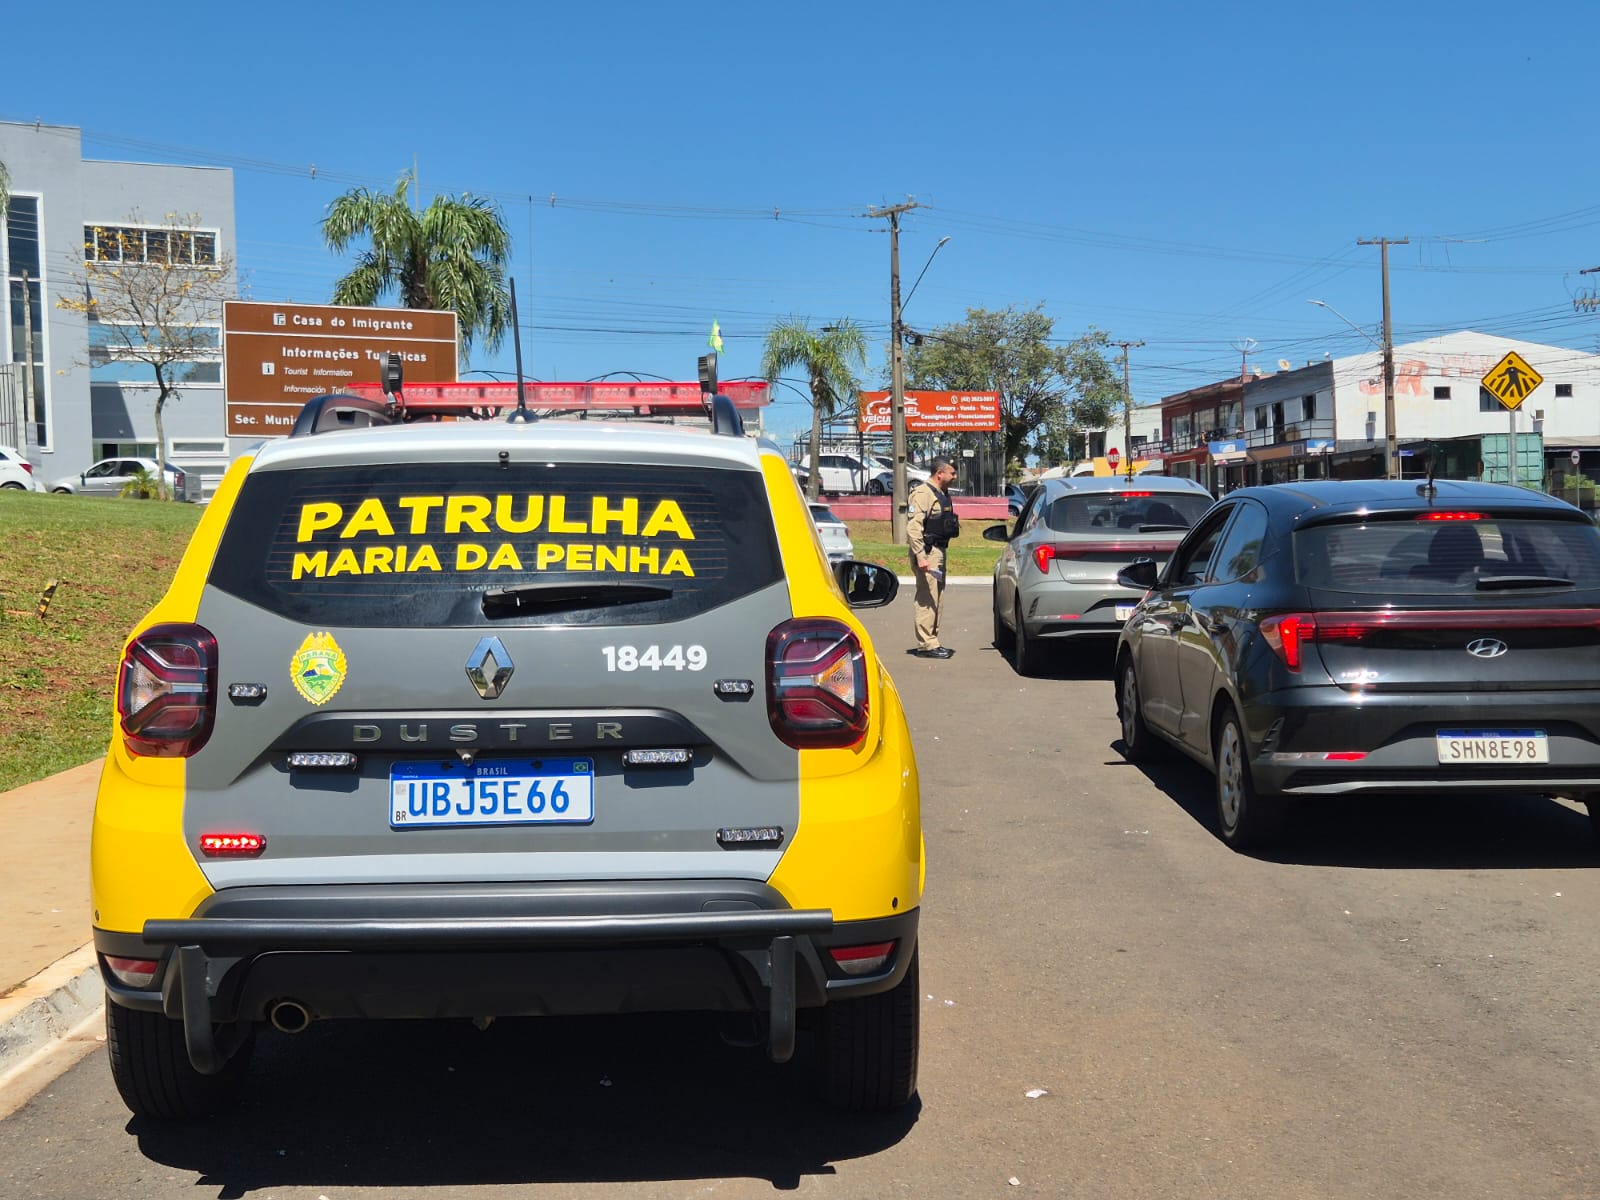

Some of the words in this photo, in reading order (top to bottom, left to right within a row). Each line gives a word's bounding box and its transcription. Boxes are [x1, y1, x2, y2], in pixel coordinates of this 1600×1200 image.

[292, 314, 323, 326] Casa
[330, 316, 346, 327] do
[352, 317, 414, 332] Imigrante
[281, 346, 360, 362] Informações
[365, 349, 428, 363] Tuticas
[284, 367, 309, 377] Tourist
[313, 367, 354, 378] Information
[284, 384, 327, 394] Información
[234, 413, 260, 425] Sec.
[296, 494, 696, 543] PATRULHA
[291, 543, 443, 580] MARIA
[455, 542, 523, 572] DA
[536, 541, 695, 578] PENHA
[601, 644, 708, 672] 18449
[352, 722, 624, 742] DUSTER
[1450, 740, 1537, 759] SHN8E98
[476, 767, 508, 776] BRASIL
[407, 779, 570, 818] UBJ5E66
[395, 810, 407, 822] BR
